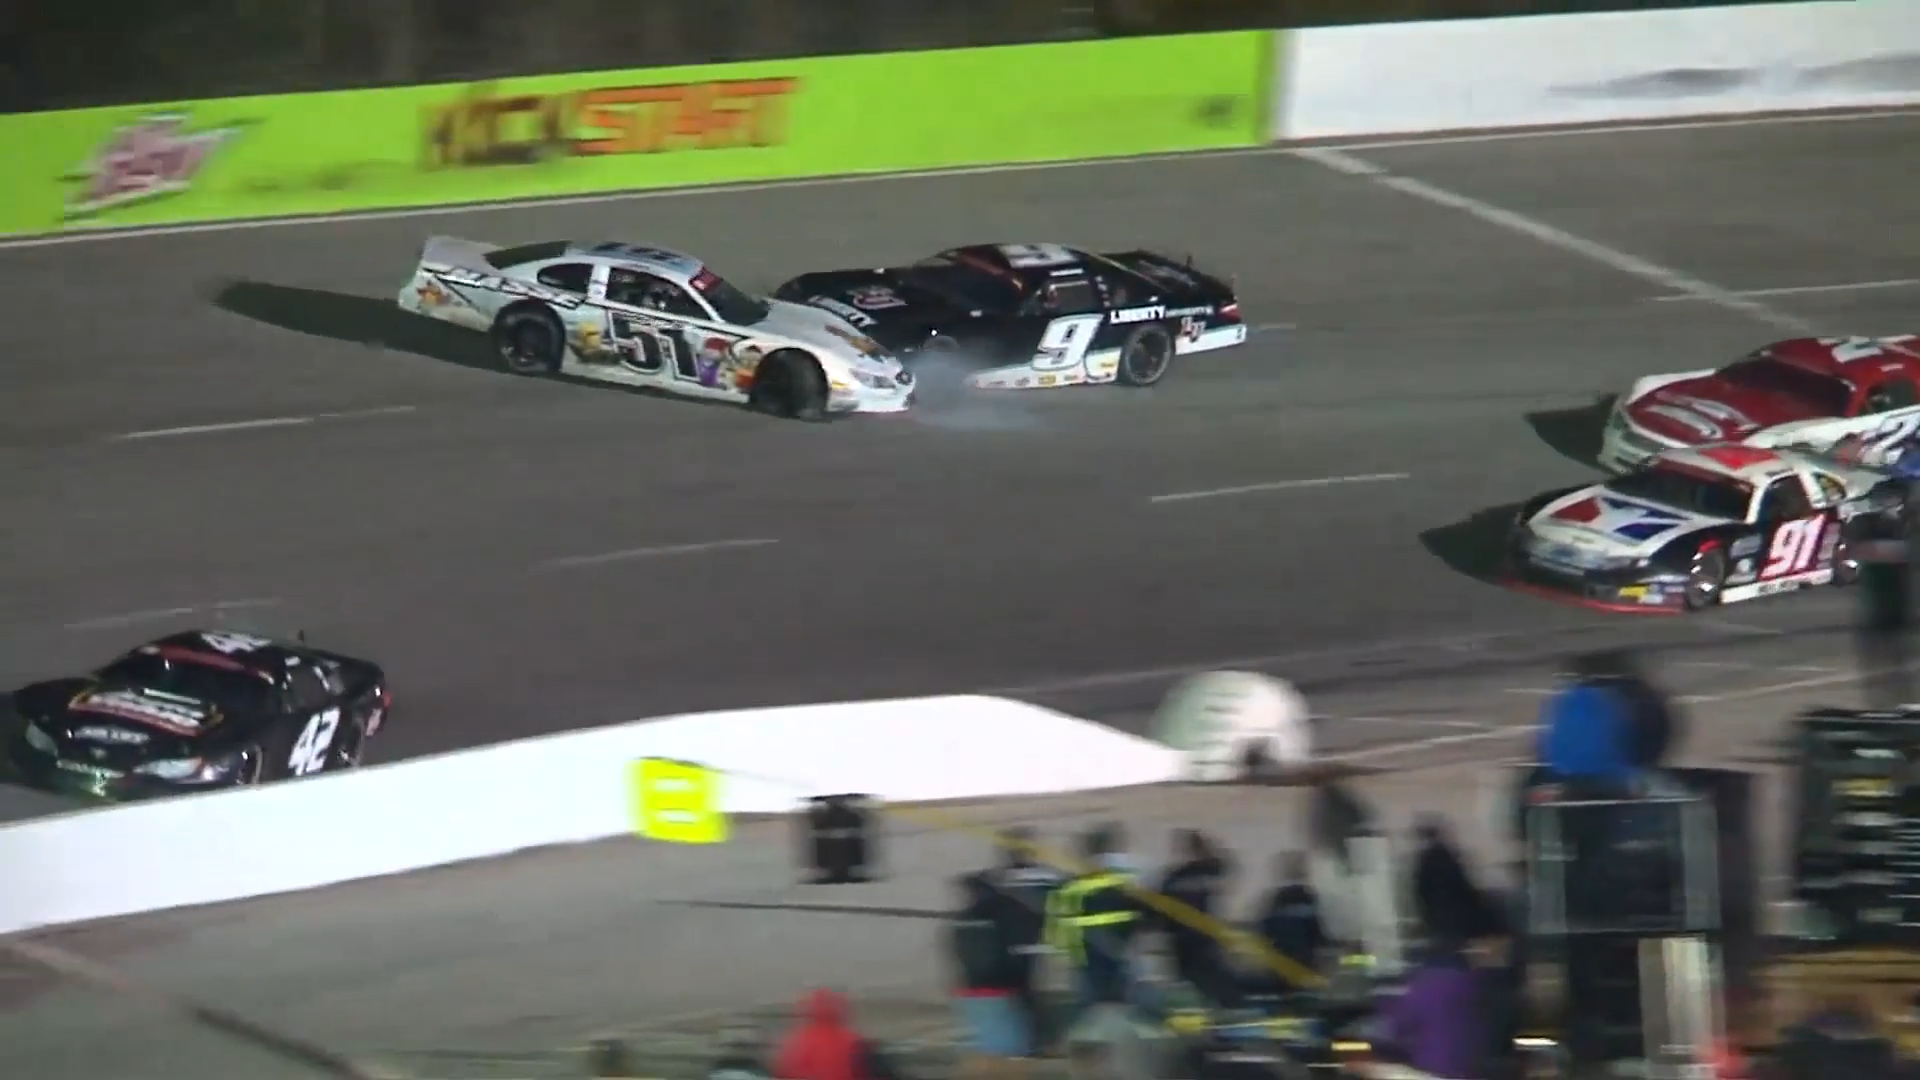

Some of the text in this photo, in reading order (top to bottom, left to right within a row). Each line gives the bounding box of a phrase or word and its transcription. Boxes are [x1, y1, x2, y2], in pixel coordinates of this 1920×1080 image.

[607, 309, 701, 383] 51
[1032, 313, 1104, 371] 9
[1759, 513, 1826, 577] 91
[288, 706, 341, 777] 42
